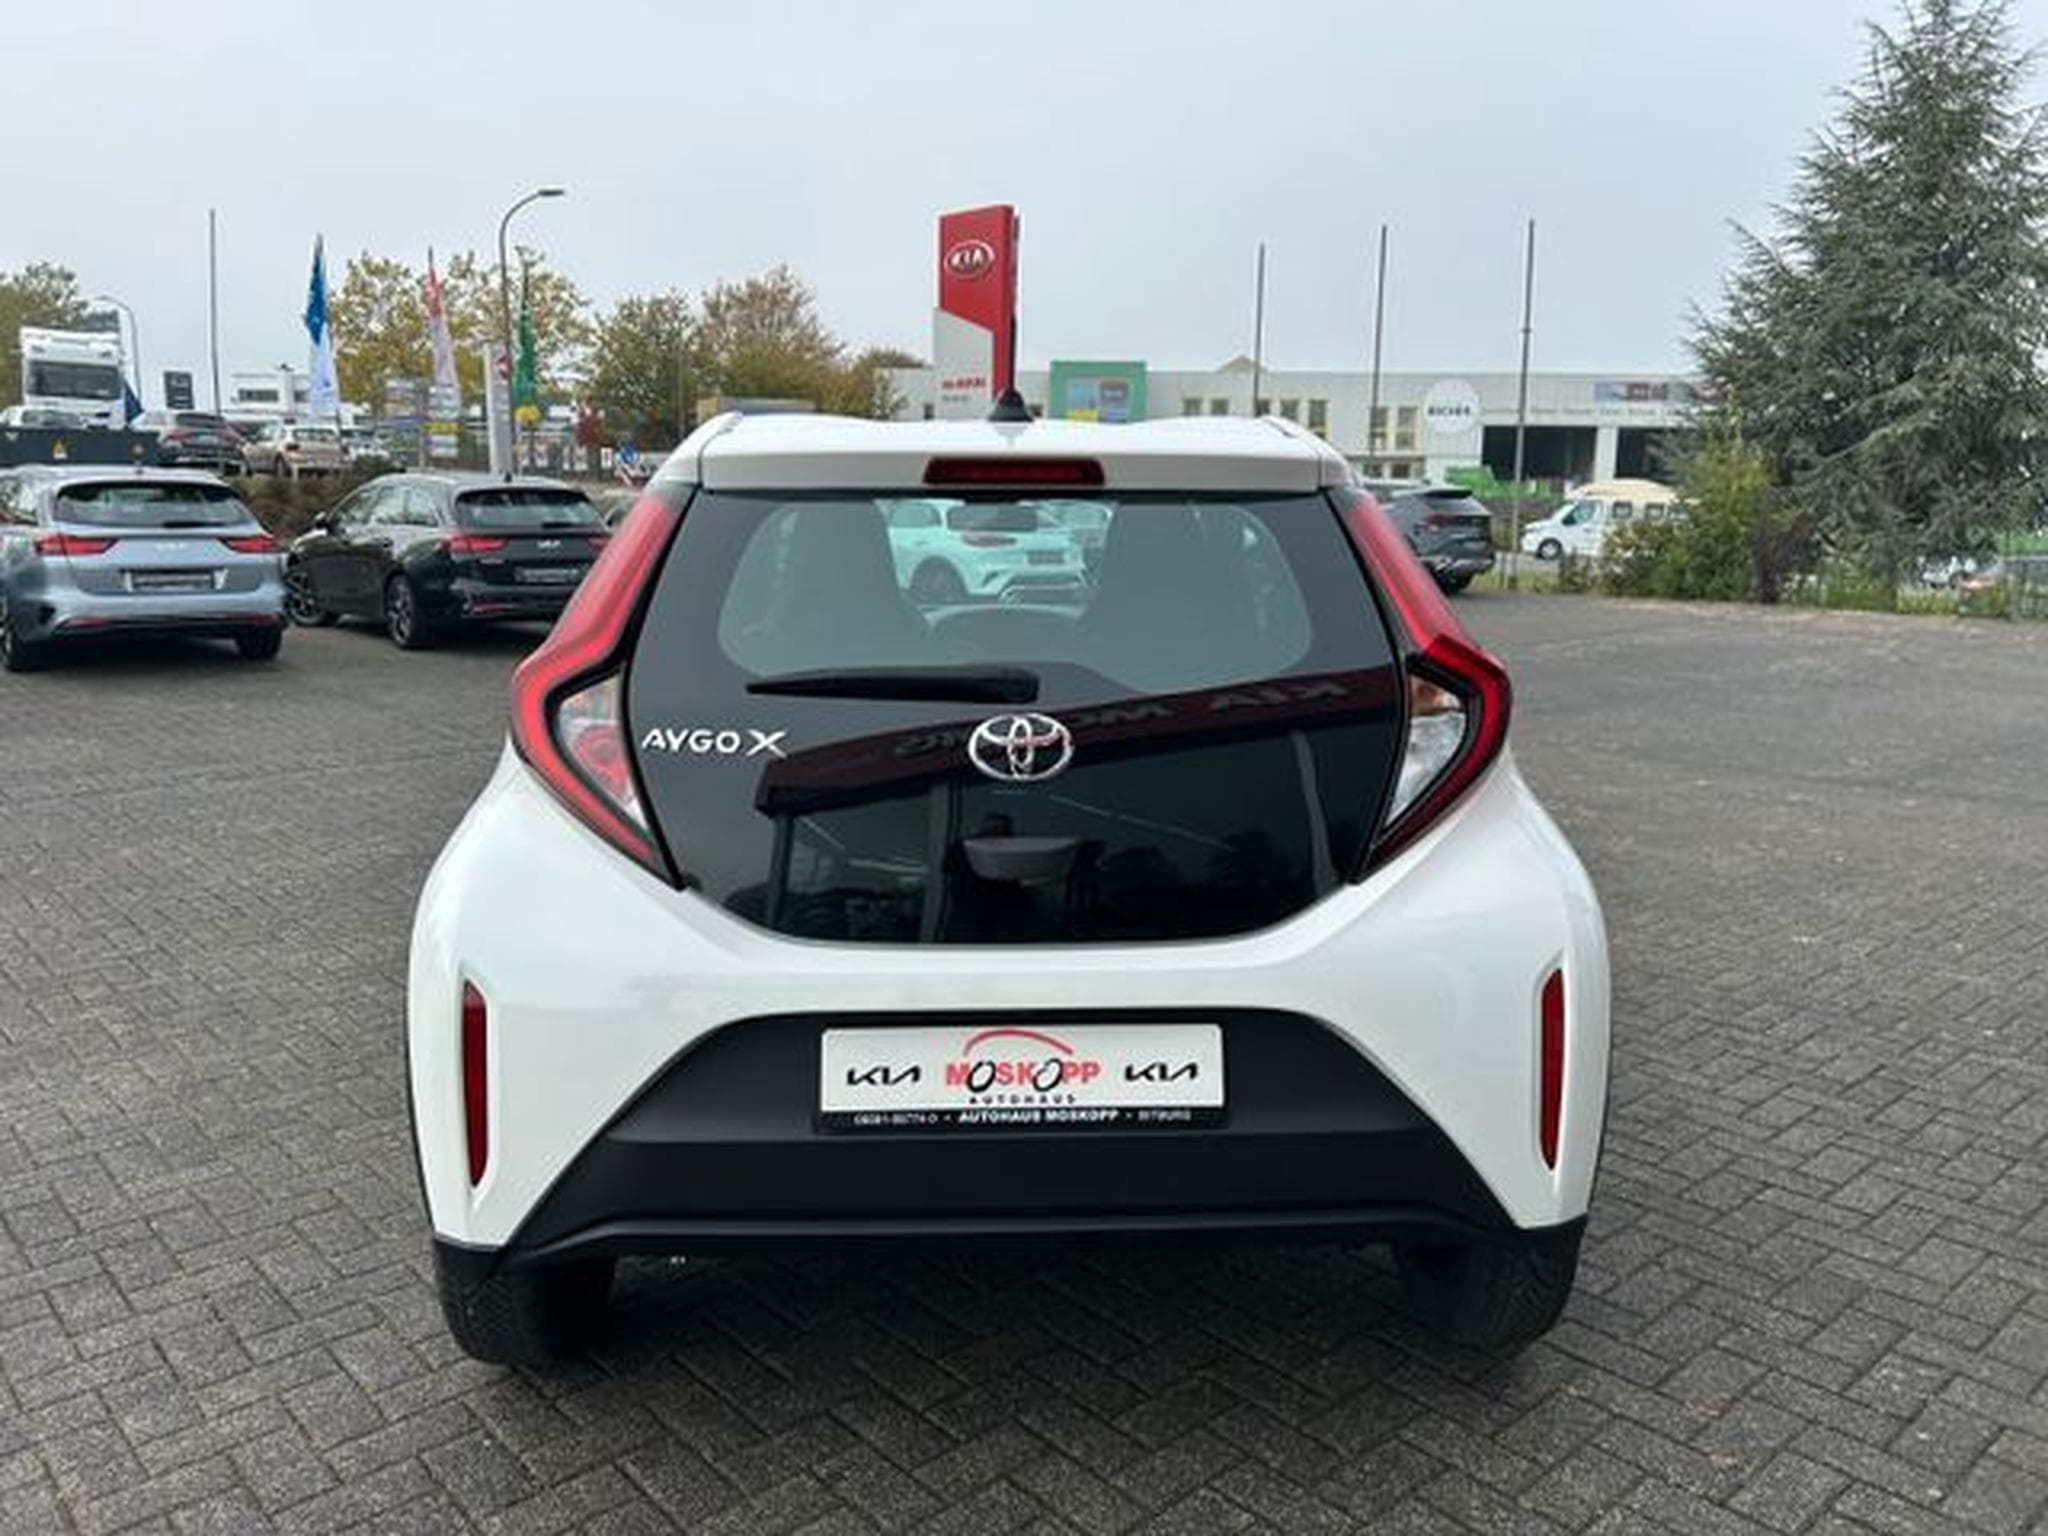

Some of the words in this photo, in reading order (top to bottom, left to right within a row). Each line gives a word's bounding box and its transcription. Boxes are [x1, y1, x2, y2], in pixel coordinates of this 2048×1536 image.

[951, 248, 984, 267] KIA
[641, 728, 741, 754] AYGO
[746, 728, 788, 759] X
[847, 1065, 922, 1087] KIA
[946, 1059, 1101, 1093] MOSKOPP
[1124, 1062, 1198, 1083] KIA
[969, 1094, 1077, 1106] AUTOHAUS
[958, 1109, 1042, 1124] AUTOHAUS
[1045, 1107, 1119, 1122] MOSKOPP
